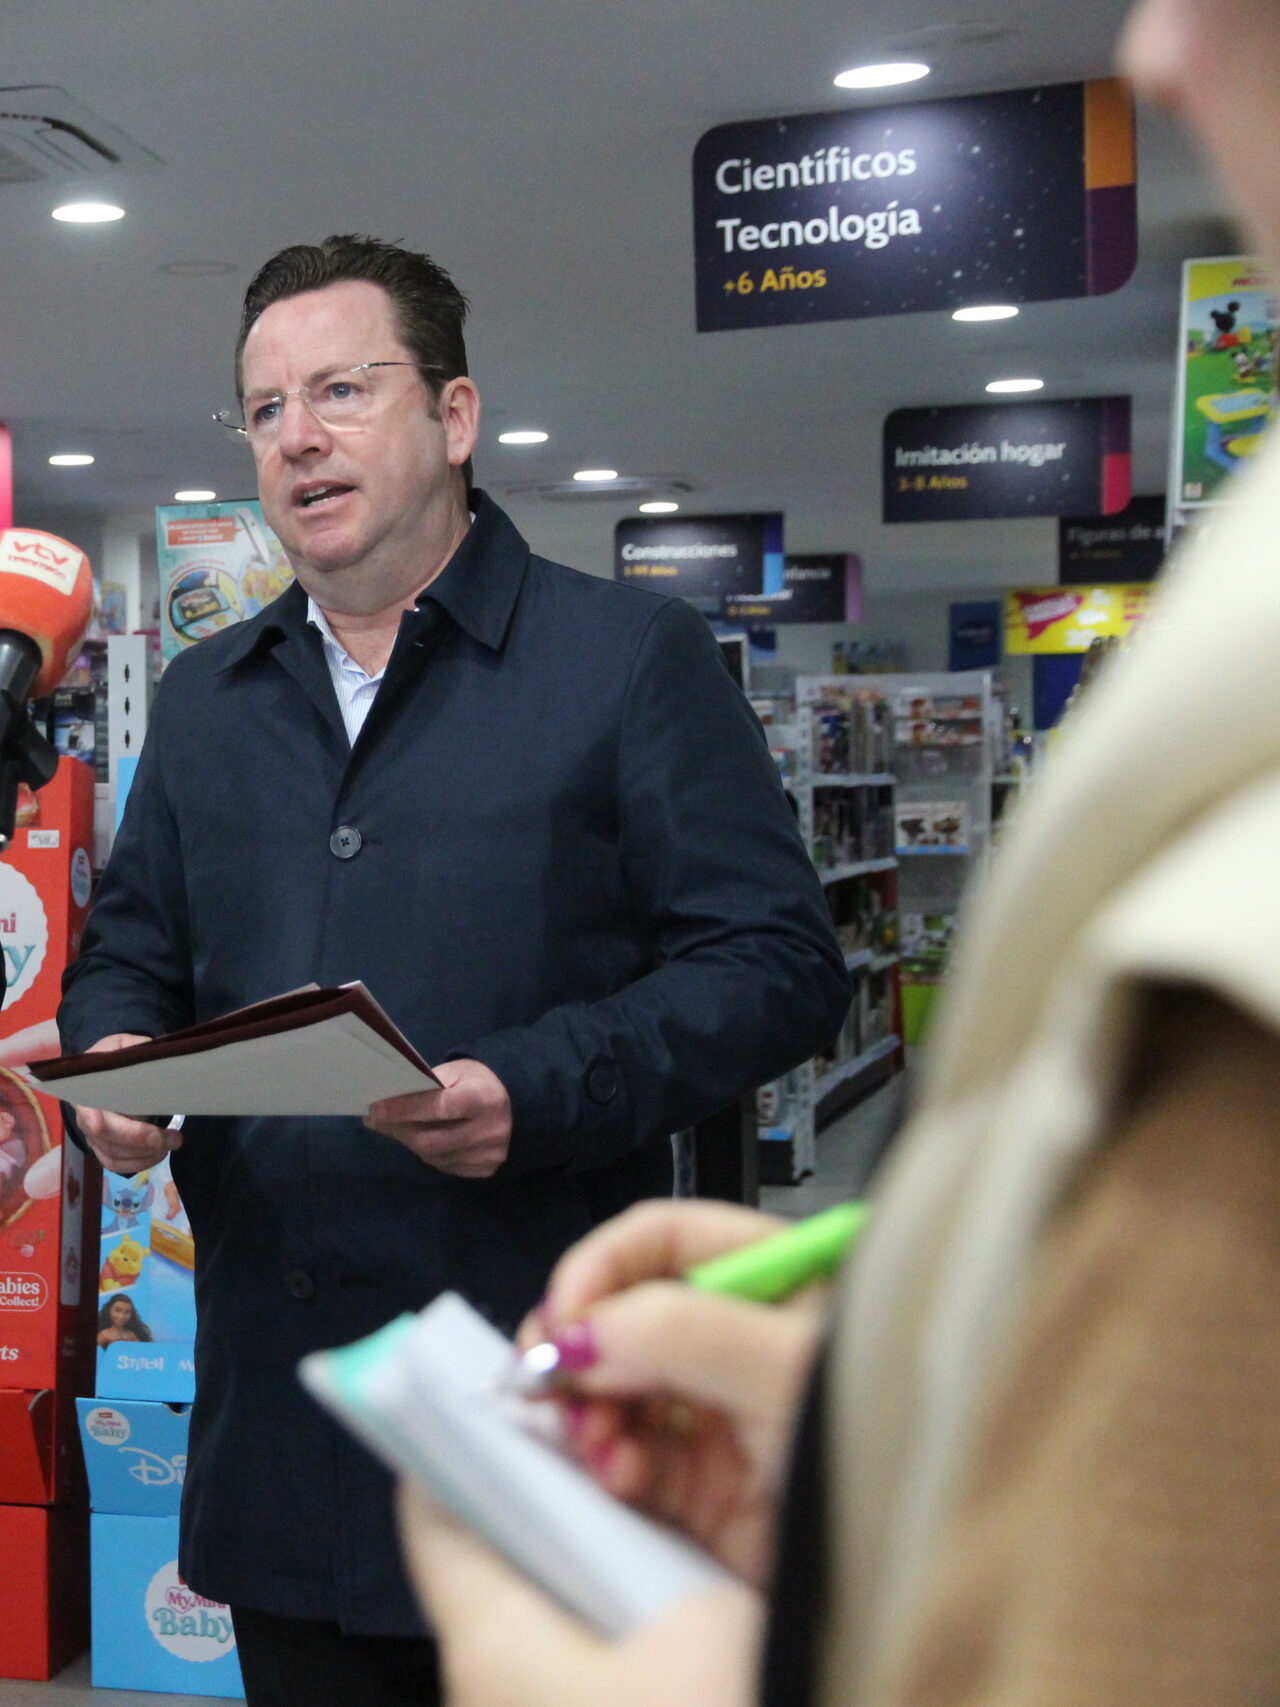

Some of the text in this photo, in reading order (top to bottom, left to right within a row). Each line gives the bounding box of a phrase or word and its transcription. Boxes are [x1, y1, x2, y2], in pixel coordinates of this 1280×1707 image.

[715, 146, 918, 194] Científicos
[715, 200, 922, 252] Tecnología
[723, 266, 828, 295] +6 Años
[895, 439, 1068, 467] Imitación hogar
[152, 1606, 233, 1644] Baby
